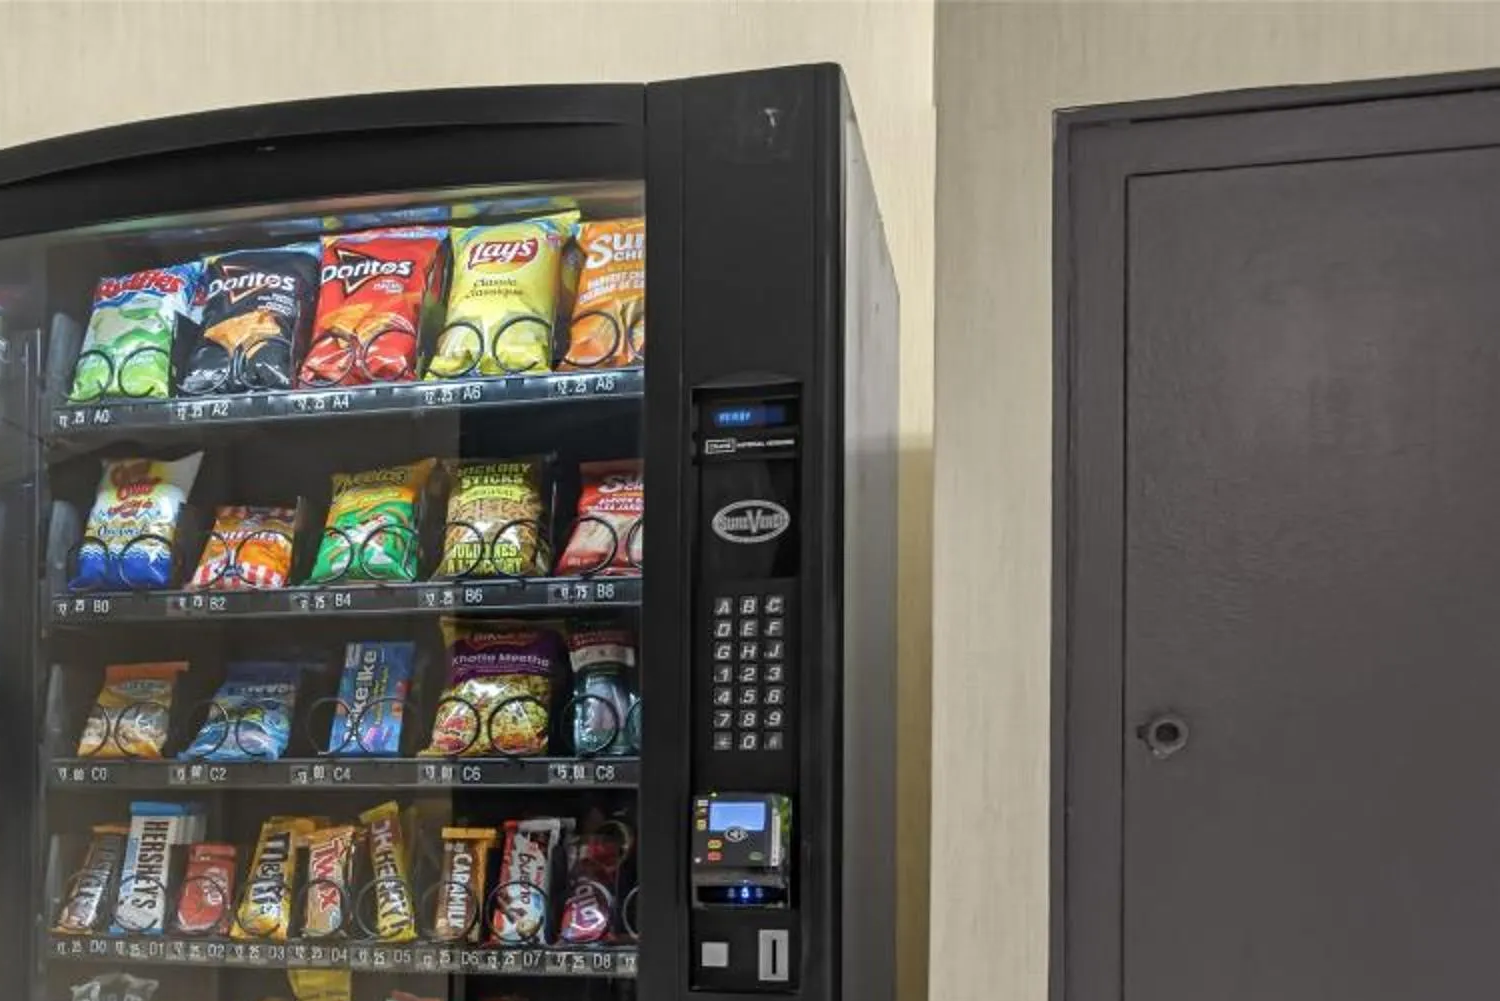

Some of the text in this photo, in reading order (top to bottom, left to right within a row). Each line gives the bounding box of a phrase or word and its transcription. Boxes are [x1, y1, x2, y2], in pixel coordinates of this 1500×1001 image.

[320, 258, 413, 285] Doritos
[204, 270, 297, 303] Doritos
[332, 394, 350, 408] A4
[211, 403, 229, 416] A2
[209, 766, 228, 782] C2
[332, 766, 352, 782] C4
[462, 766, 482, 781] C6
[132, 820, 169, 910] HERSHEY'S
[447, 852, 473, 930] CARAMILK
[523, 951, 541, 966] D7
[593, 953, 612, 968] D8
